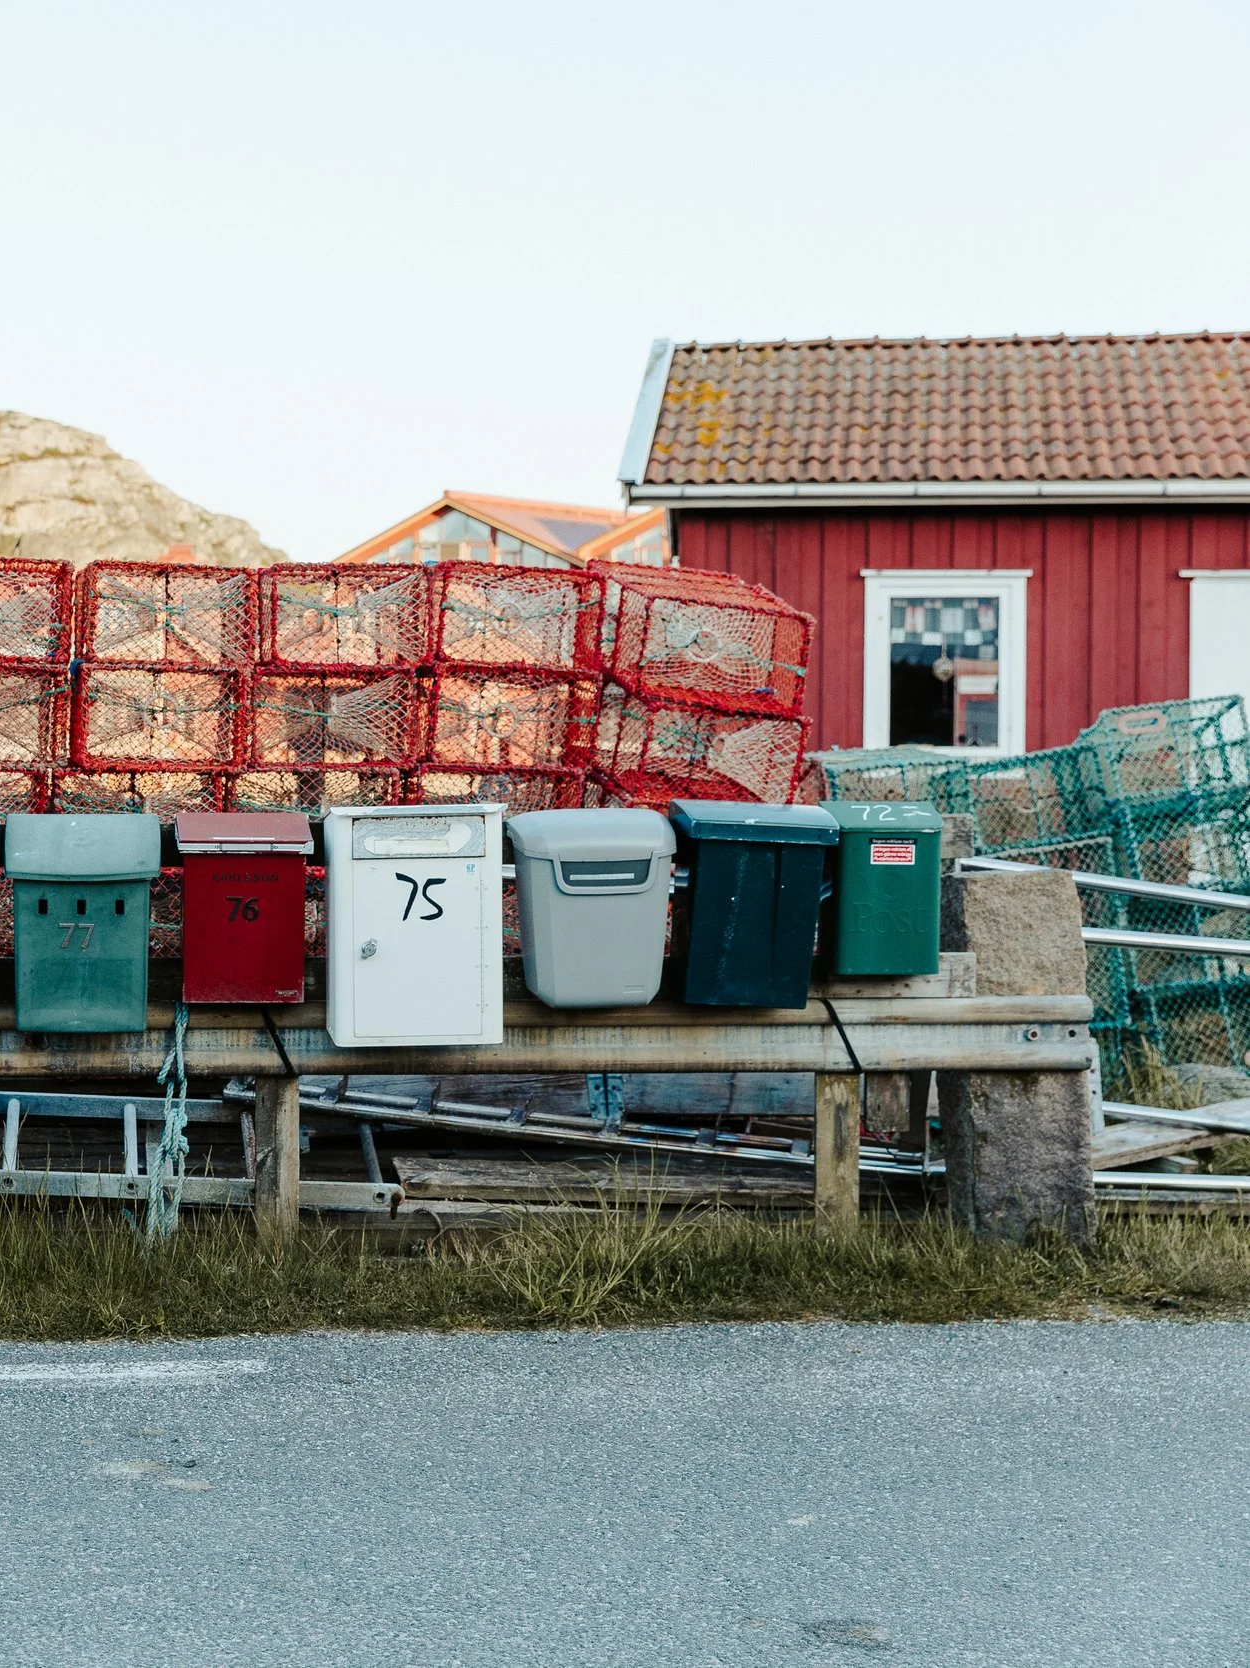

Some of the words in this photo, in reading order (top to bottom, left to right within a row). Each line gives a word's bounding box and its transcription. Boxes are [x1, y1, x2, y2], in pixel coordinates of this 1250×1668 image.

[851, 805, 896, 820] 72
[226, 895, 259, 922] 76
[395, 872, 447, 921] 75
[850, 902, 929, 933] Post
[59, 922, 95, 949] 77
